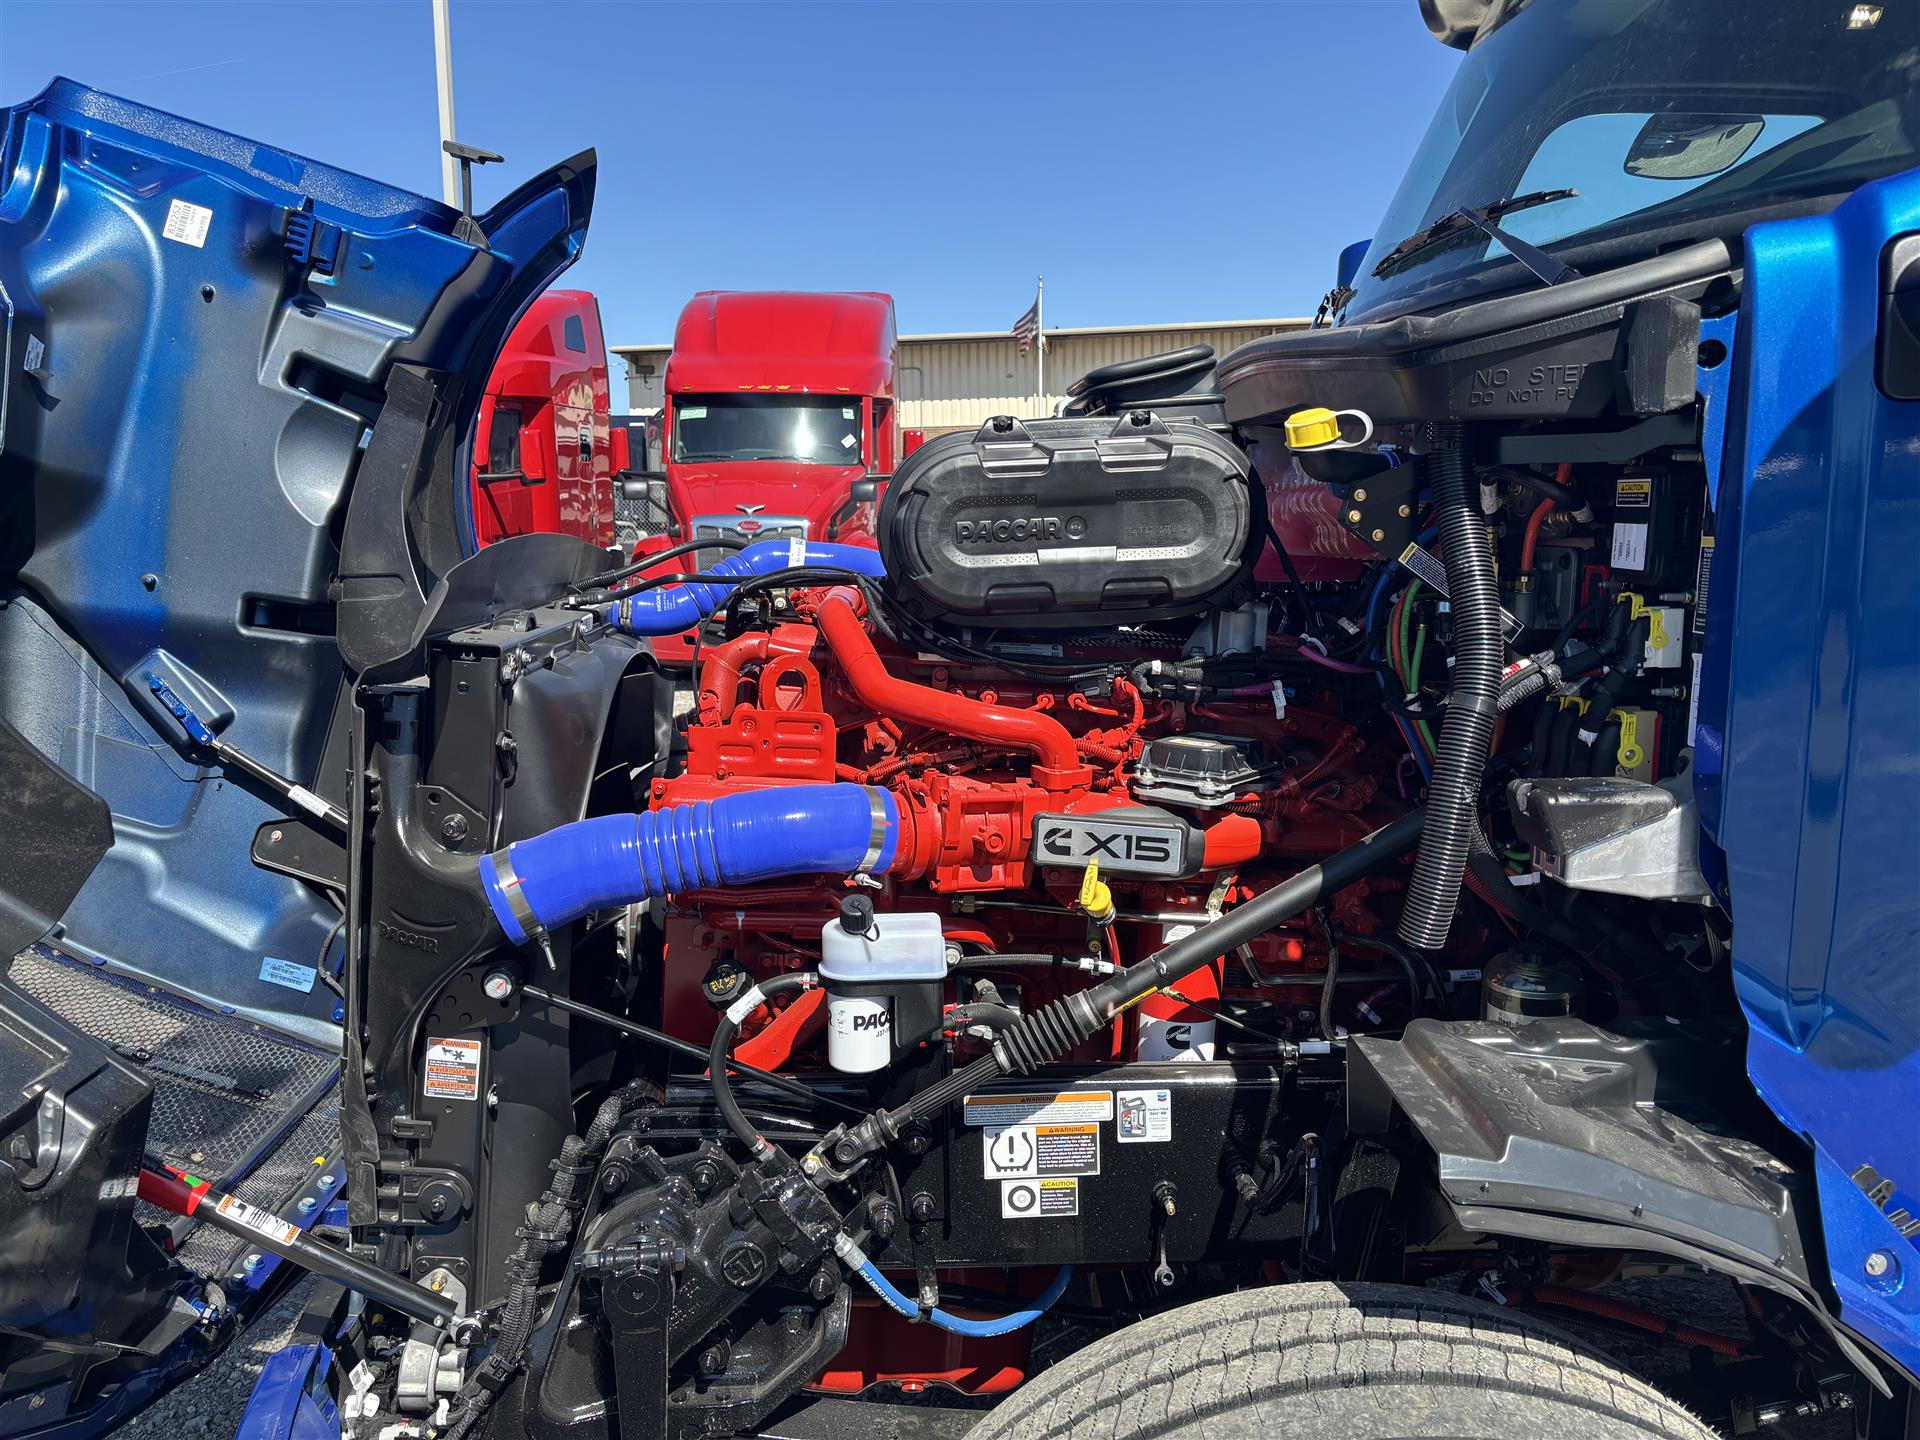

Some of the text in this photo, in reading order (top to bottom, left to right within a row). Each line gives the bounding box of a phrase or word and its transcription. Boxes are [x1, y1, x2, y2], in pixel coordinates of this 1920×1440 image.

[1473, 368, 1510, 389] NO
[1471, 391, 1495, 404] DO
[1507, 388, 1545, 403] NOT
[955, 517, 1062, 545] PACCAR
[1082, 831, 1171, 862] X15
[445, 1040, 470, 1048] WARNING
[1026, 1095, 1056, 1103] WARNING
[1046, 1180, 1076, 1188] CAUTION
